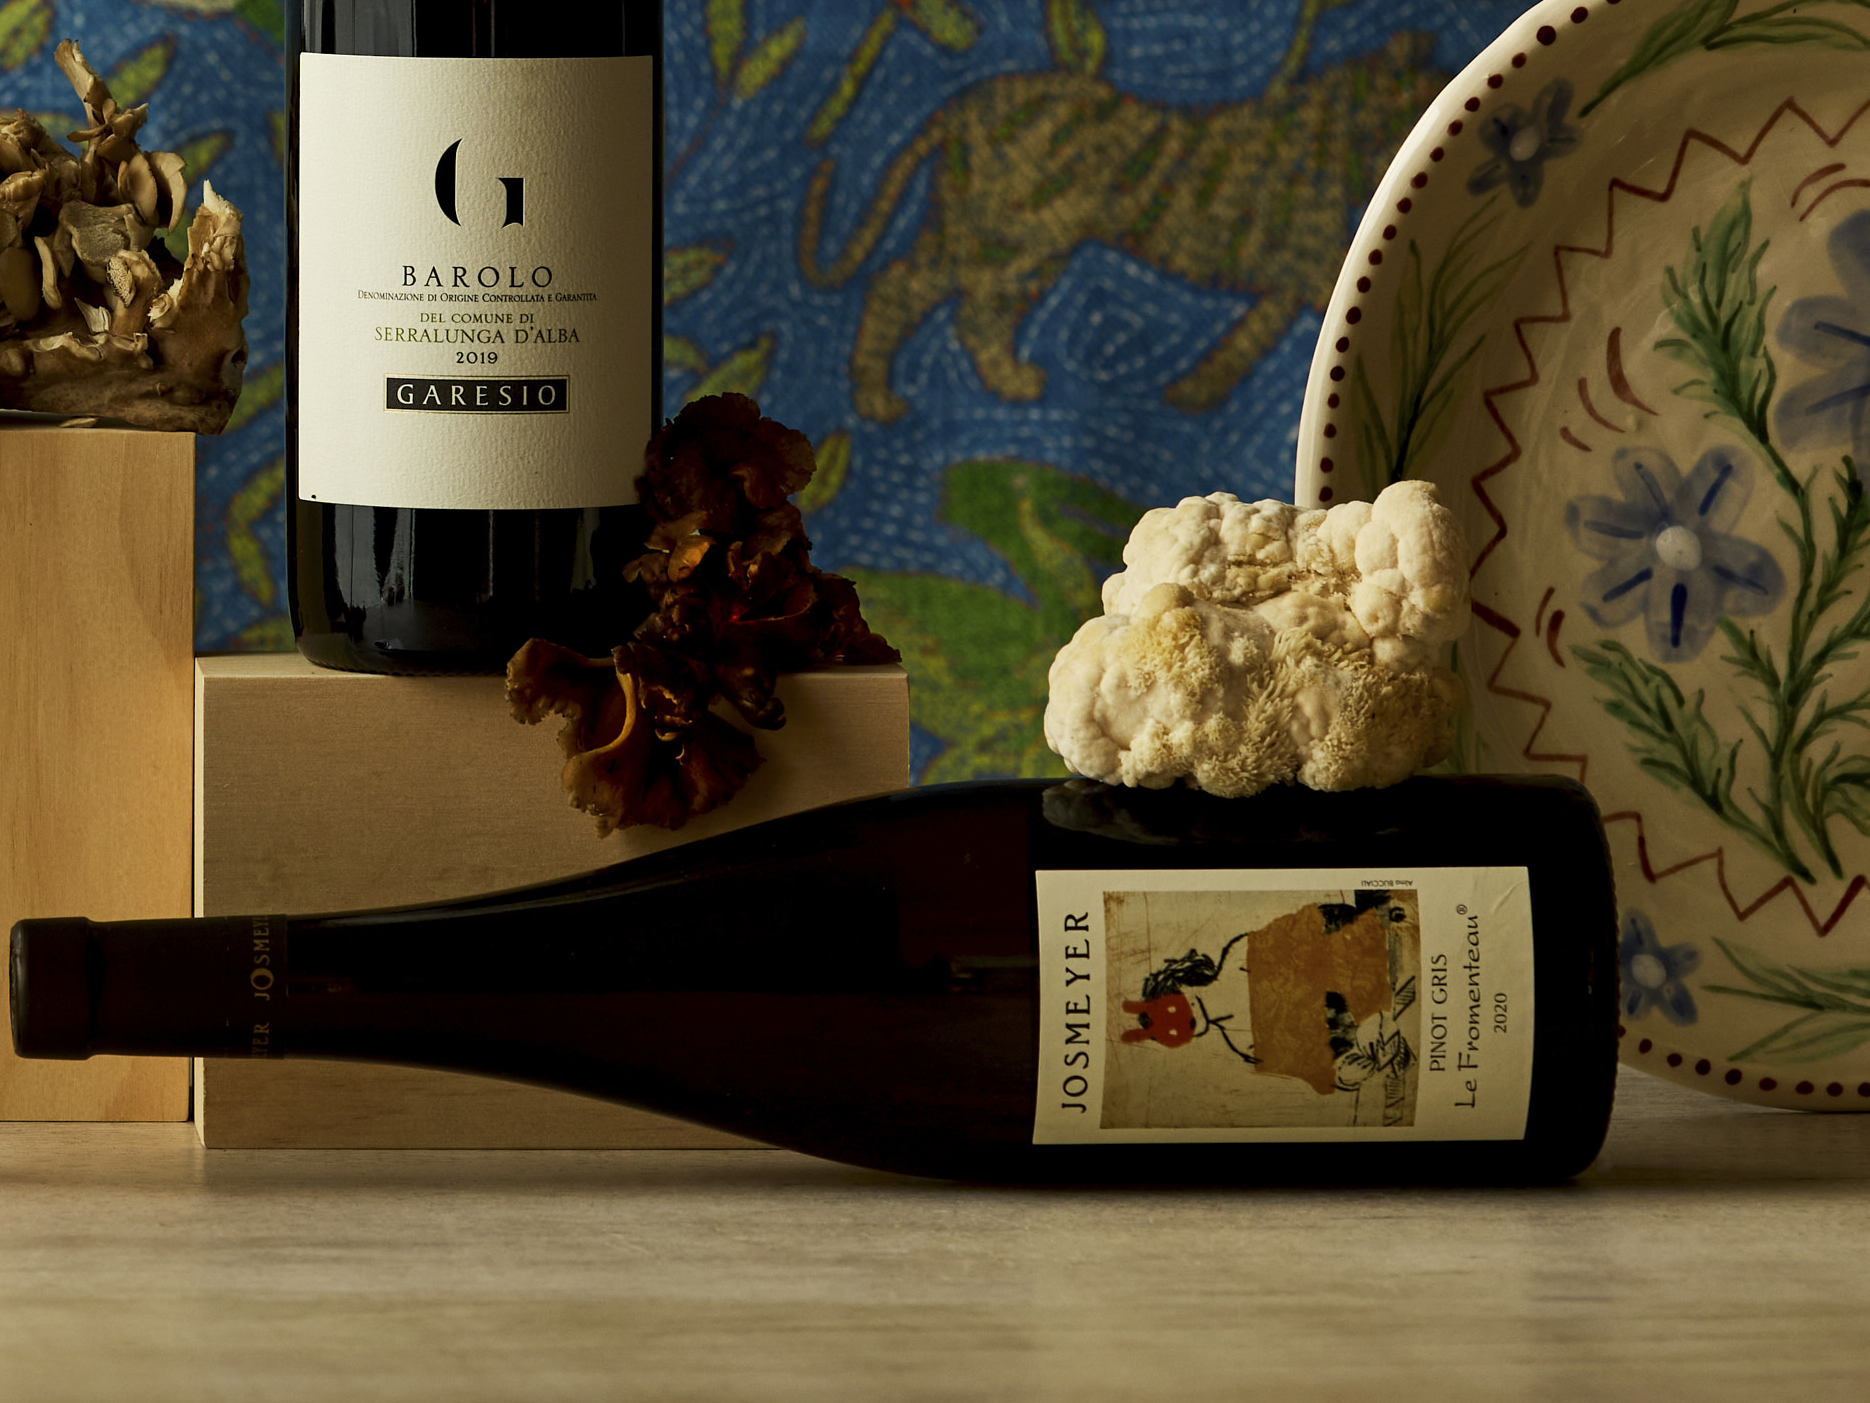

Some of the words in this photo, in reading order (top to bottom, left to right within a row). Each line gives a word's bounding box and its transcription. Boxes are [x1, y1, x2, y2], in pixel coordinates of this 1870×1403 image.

[401, 264, 554, 289] BAROLO
[357, 289, 425, 303] DENOMINAZIONE
[427, 293, 438, 302] DI
[439, 292, 479, 303] ORIGINE
[482, 292, 546, 303] CONTROLLATA
[547, 293, 554, 303] E
[555, 291, 597, 303] GARANTITA
[420, 312, 446, 324] DEL
[451, 312, 514, 325] COMUNE
[519, 312, 535, 324] DI
[374, 326, 506, 345] SERRALUNGA
[514, 326, 581, 344] D'ALBA
[455, 351, 499, 365] 2019
[396, 383, 557, 407] GARESIO
[1430, 953, 1448, 1005] GRIS
[1061, 911, 1091, 1113] JOSMEYER
[1493, 992, 1508, 1034] 2020
[1428, 1013, 1448, 1072] PINOT
[1453, 1078, 1478, 1109] Le
